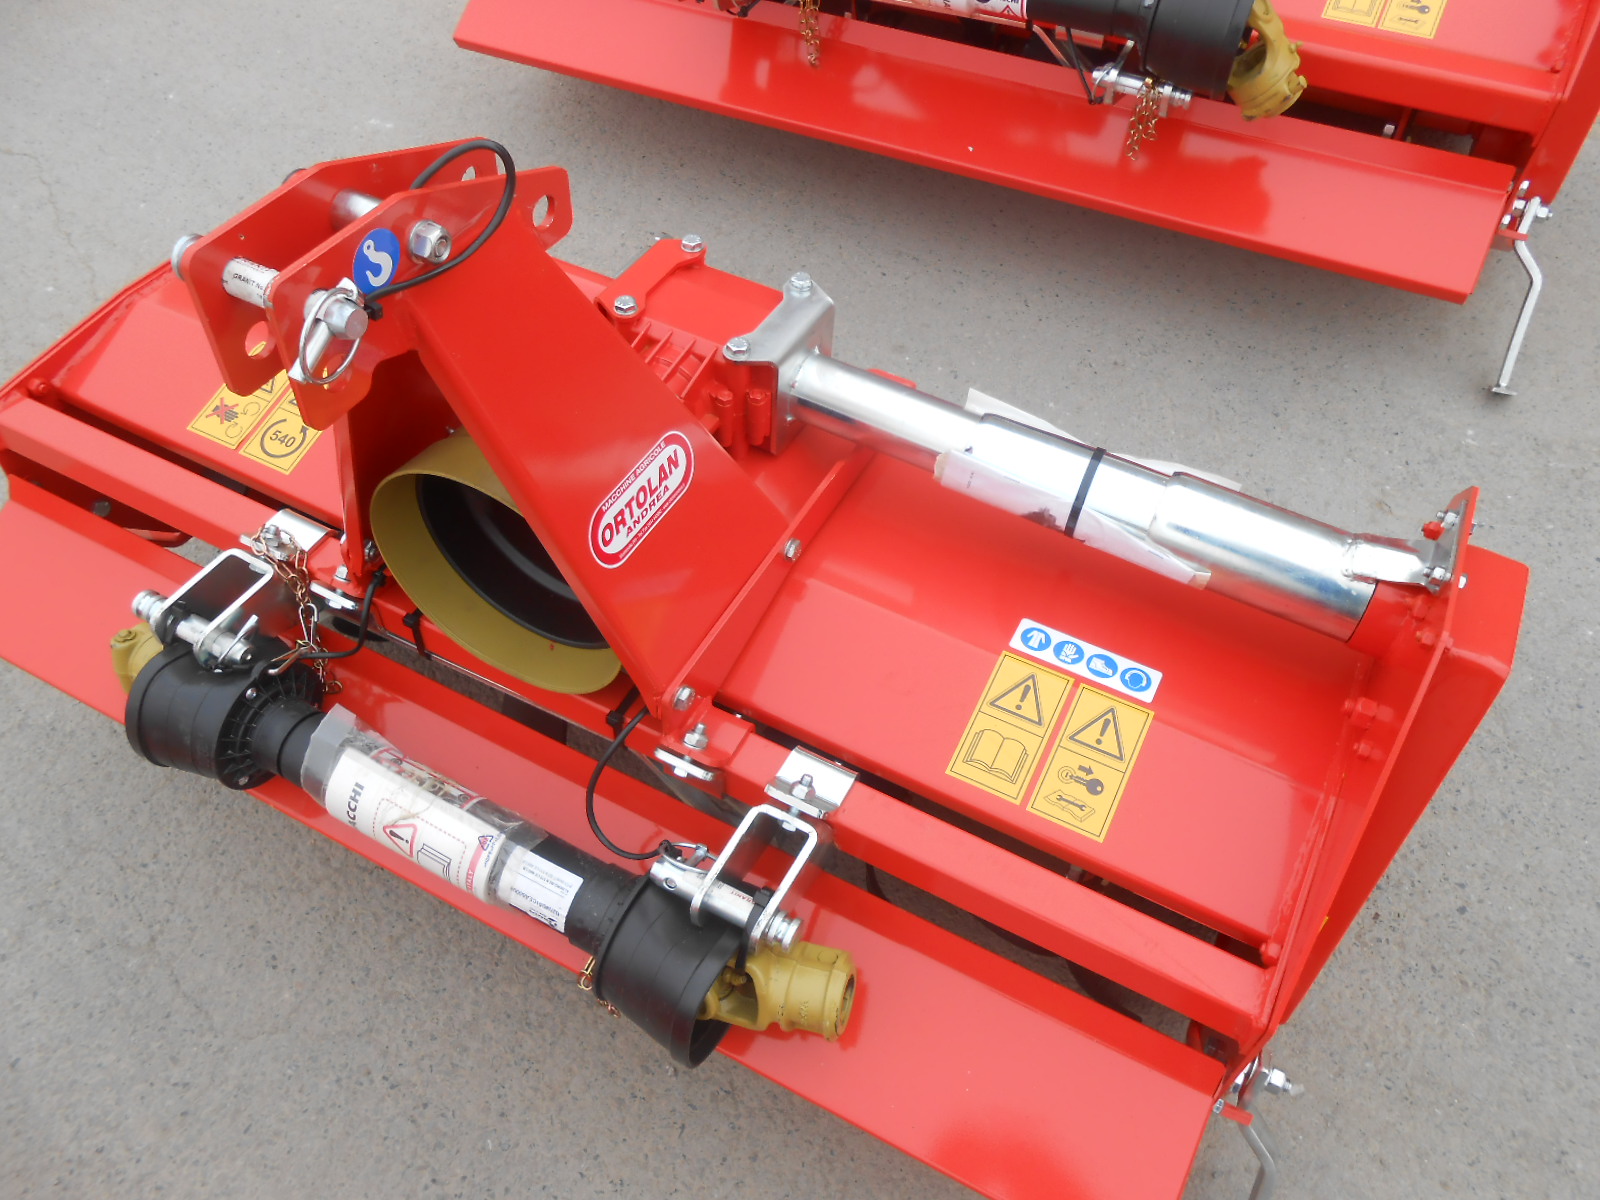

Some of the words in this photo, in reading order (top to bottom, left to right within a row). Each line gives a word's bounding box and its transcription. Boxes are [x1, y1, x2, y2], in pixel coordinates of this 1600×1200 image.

[270, 430, 296, 447] 540
[601, 475, 637, 512] MACCHINE
[635, 441, 666, 477] AGRICOLE
[602, 449, 680, 547] ORTOLAN
[626, 485, 669, 537] ANDREA
